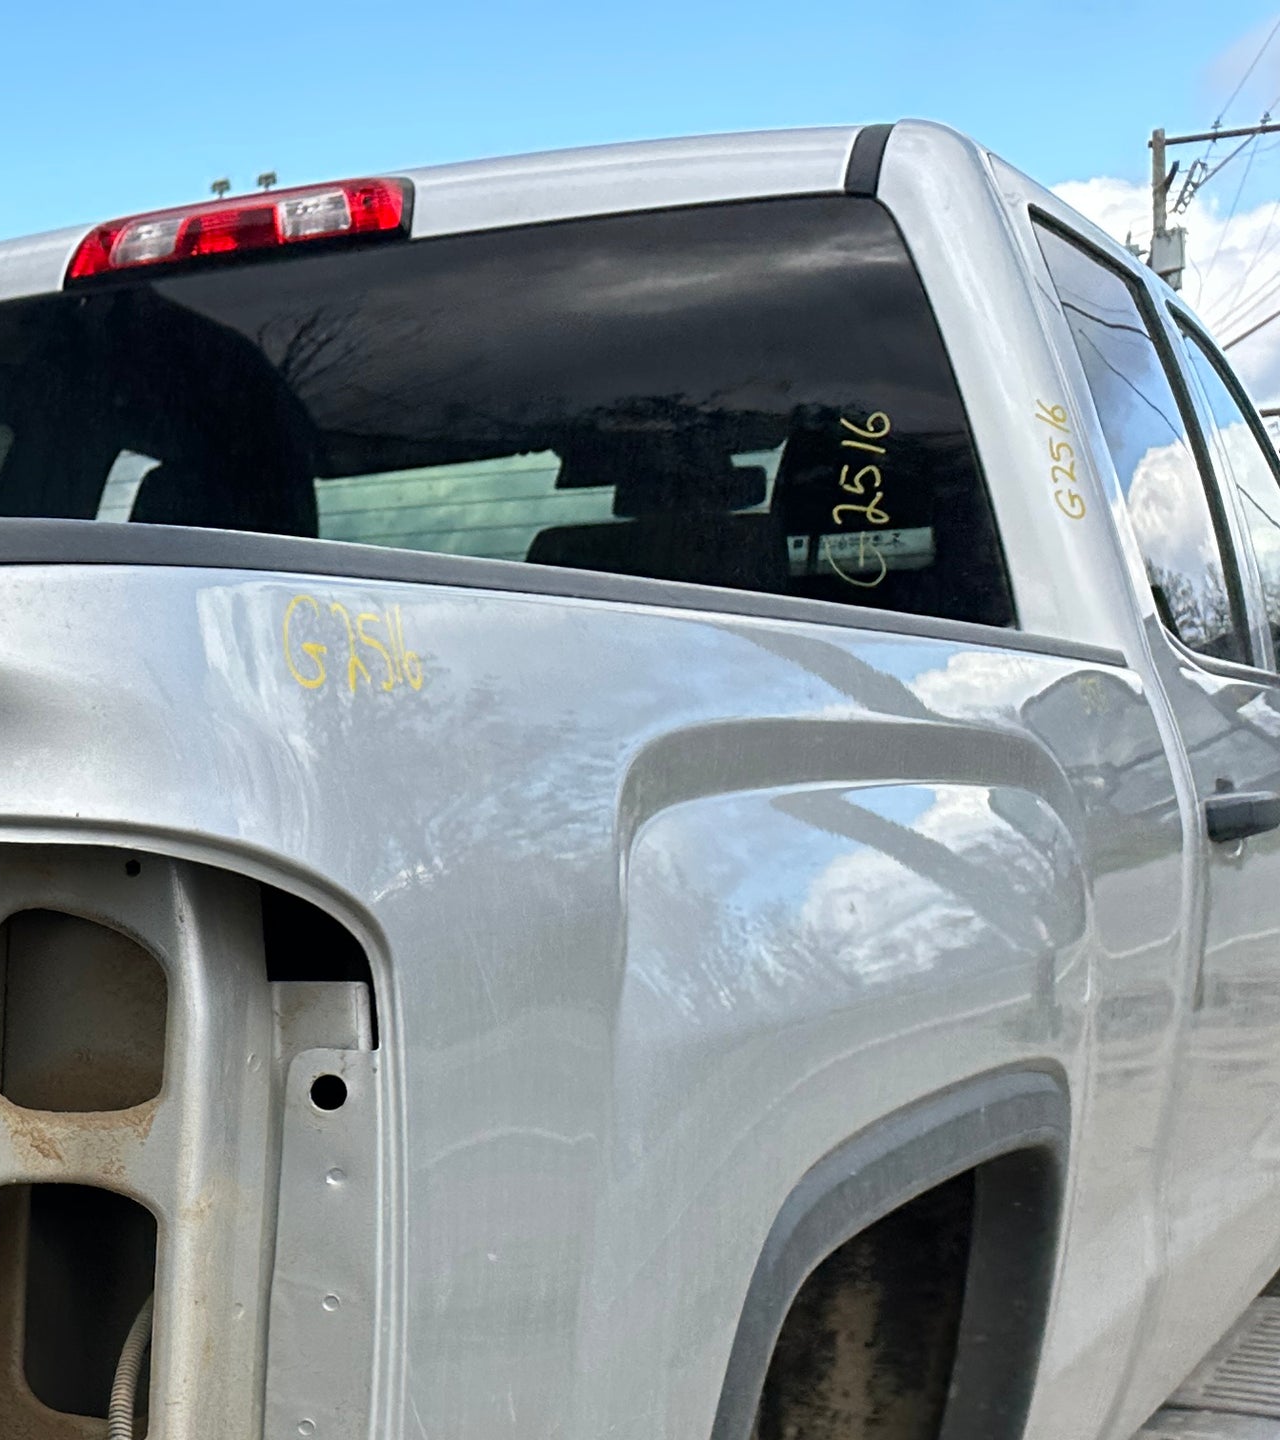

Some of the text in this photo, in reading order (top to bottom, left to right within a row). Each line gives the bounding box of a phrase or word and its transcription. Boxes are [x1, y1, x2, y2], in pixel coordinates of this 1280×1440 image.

[826, 411, 890, 588] G2516
[1036, 398, 1086, 520] G2516
[282, 594, 423, 692] G2516
